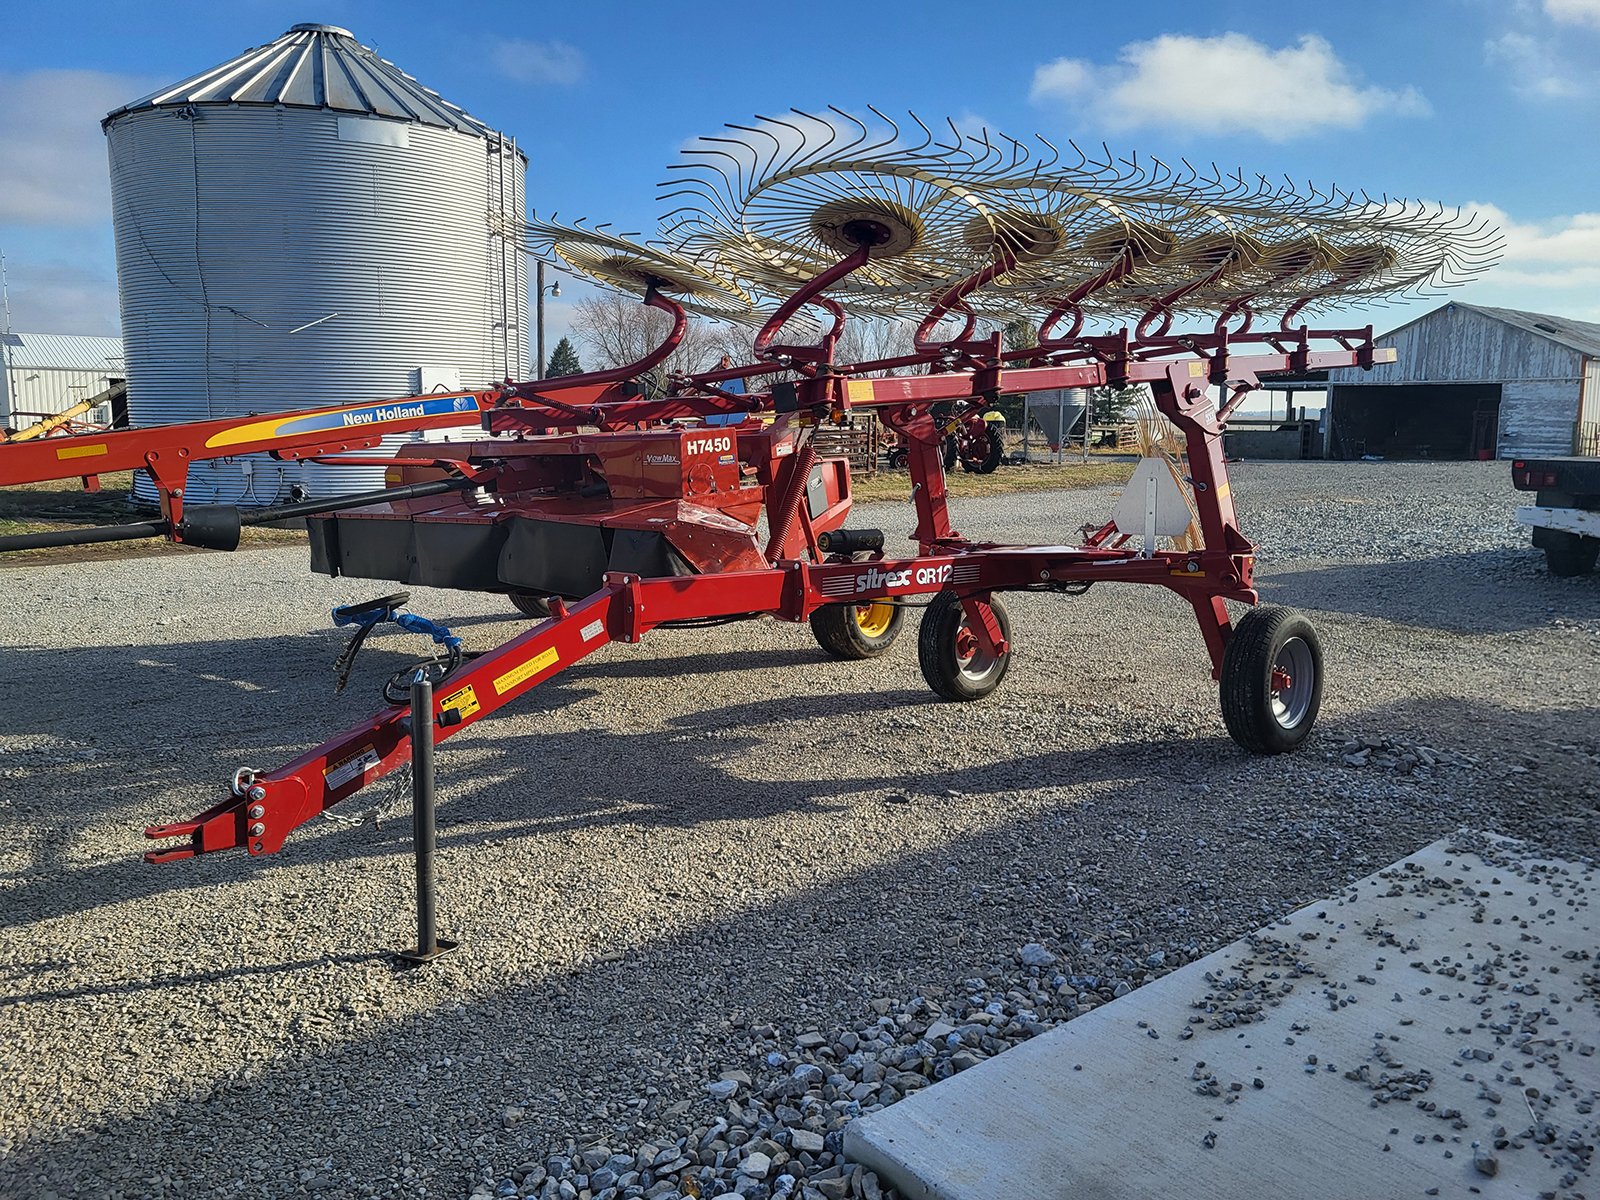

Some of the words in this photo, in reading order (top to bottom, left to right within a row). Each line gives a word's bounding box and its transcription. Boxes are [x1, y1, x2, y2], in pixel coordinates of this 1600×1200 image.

[343, 412, 373, 426] New
[376, 404, 425, 421] Holland
[687, 437, 731, 456] H7450
[856, 567, 913, 592] sitrex
[916, 564, 953, 585] QR12
[495, 670, 518, 685] MAXIMUM
[519, 661, 533, 671] SPEED
[542, 649, 555, 659] ROAD
[338, 749, 364, 765] WARNING
